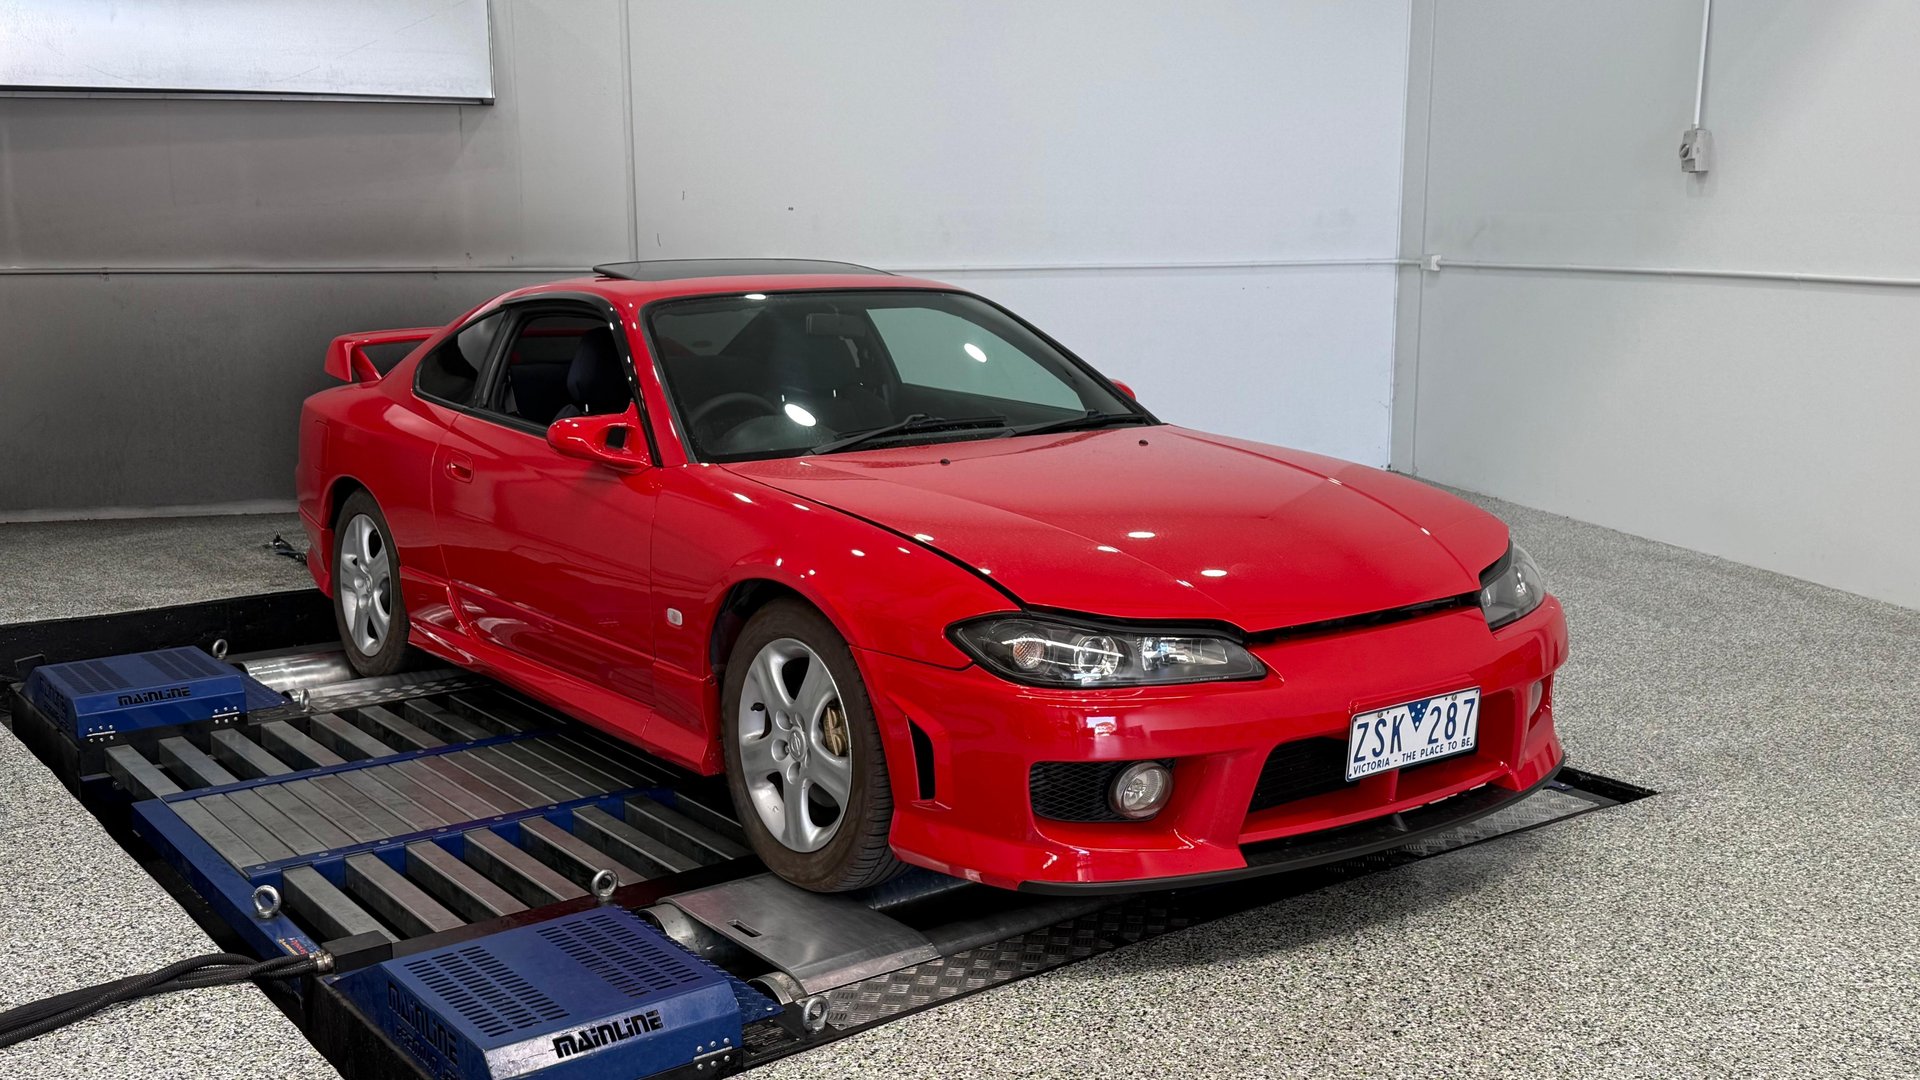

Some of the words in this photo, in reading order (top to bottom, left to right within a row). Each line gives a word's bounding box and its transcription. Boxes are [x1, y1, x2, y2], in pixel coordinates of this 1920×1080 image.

[1353, 713, 1405, 763] ZSK
[1427, 698, 1475, 745] 287
[1353, 759, 1390, 775] VICTORIA
[1402, 750, 1416, 762] THE
[1420, 744, 1444, 758] PLACE
[1447, 740, 1457, 751] TO
[1461, 736, 1473, 748] BE.
